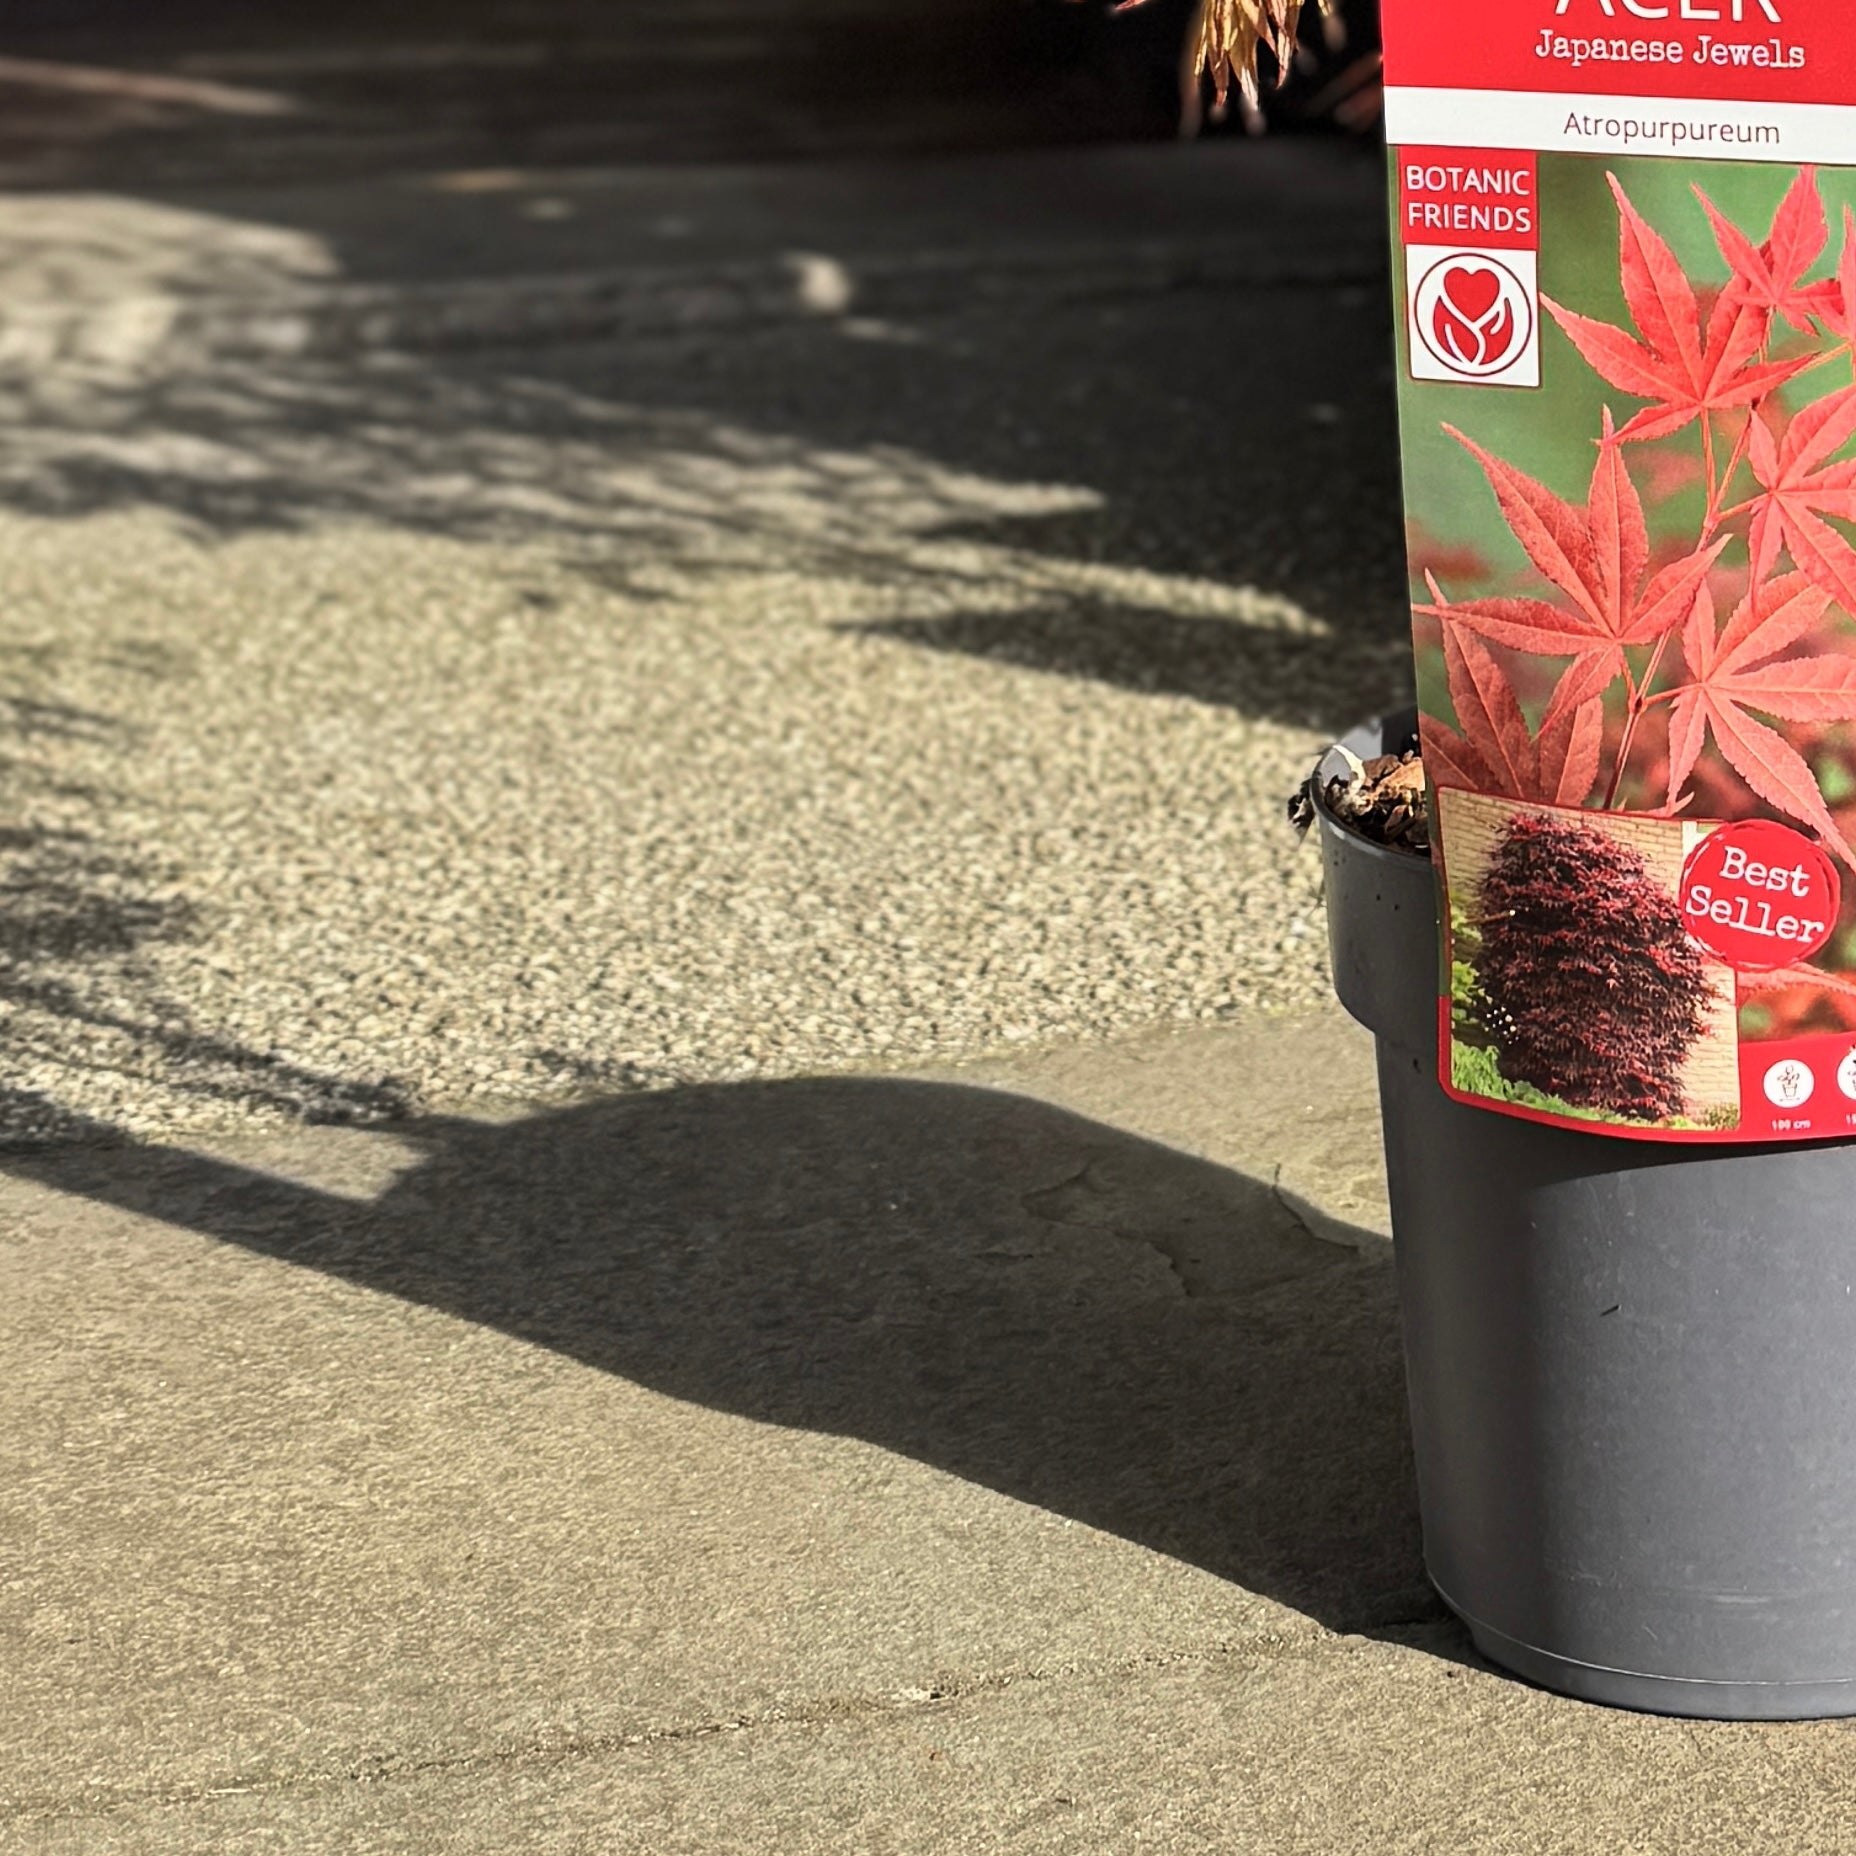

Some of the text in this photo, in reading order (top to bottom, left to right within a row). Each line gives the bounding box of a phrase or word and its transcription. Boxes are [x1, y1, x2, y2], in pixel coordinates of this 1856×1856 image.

[1534, 29, 1806, 68] Japanese Jewels
[1563, 111, 1781, 146] Atropurpureum
[1405, 165, 1530, 196] BOTANIC
[1407, 202, 1532, 233] FRIENDS
[1719, 845, 1810, 897] Best
[1686, 885, 1825, 943] Seller
[1793, 1119, 1811, 1130] cm
